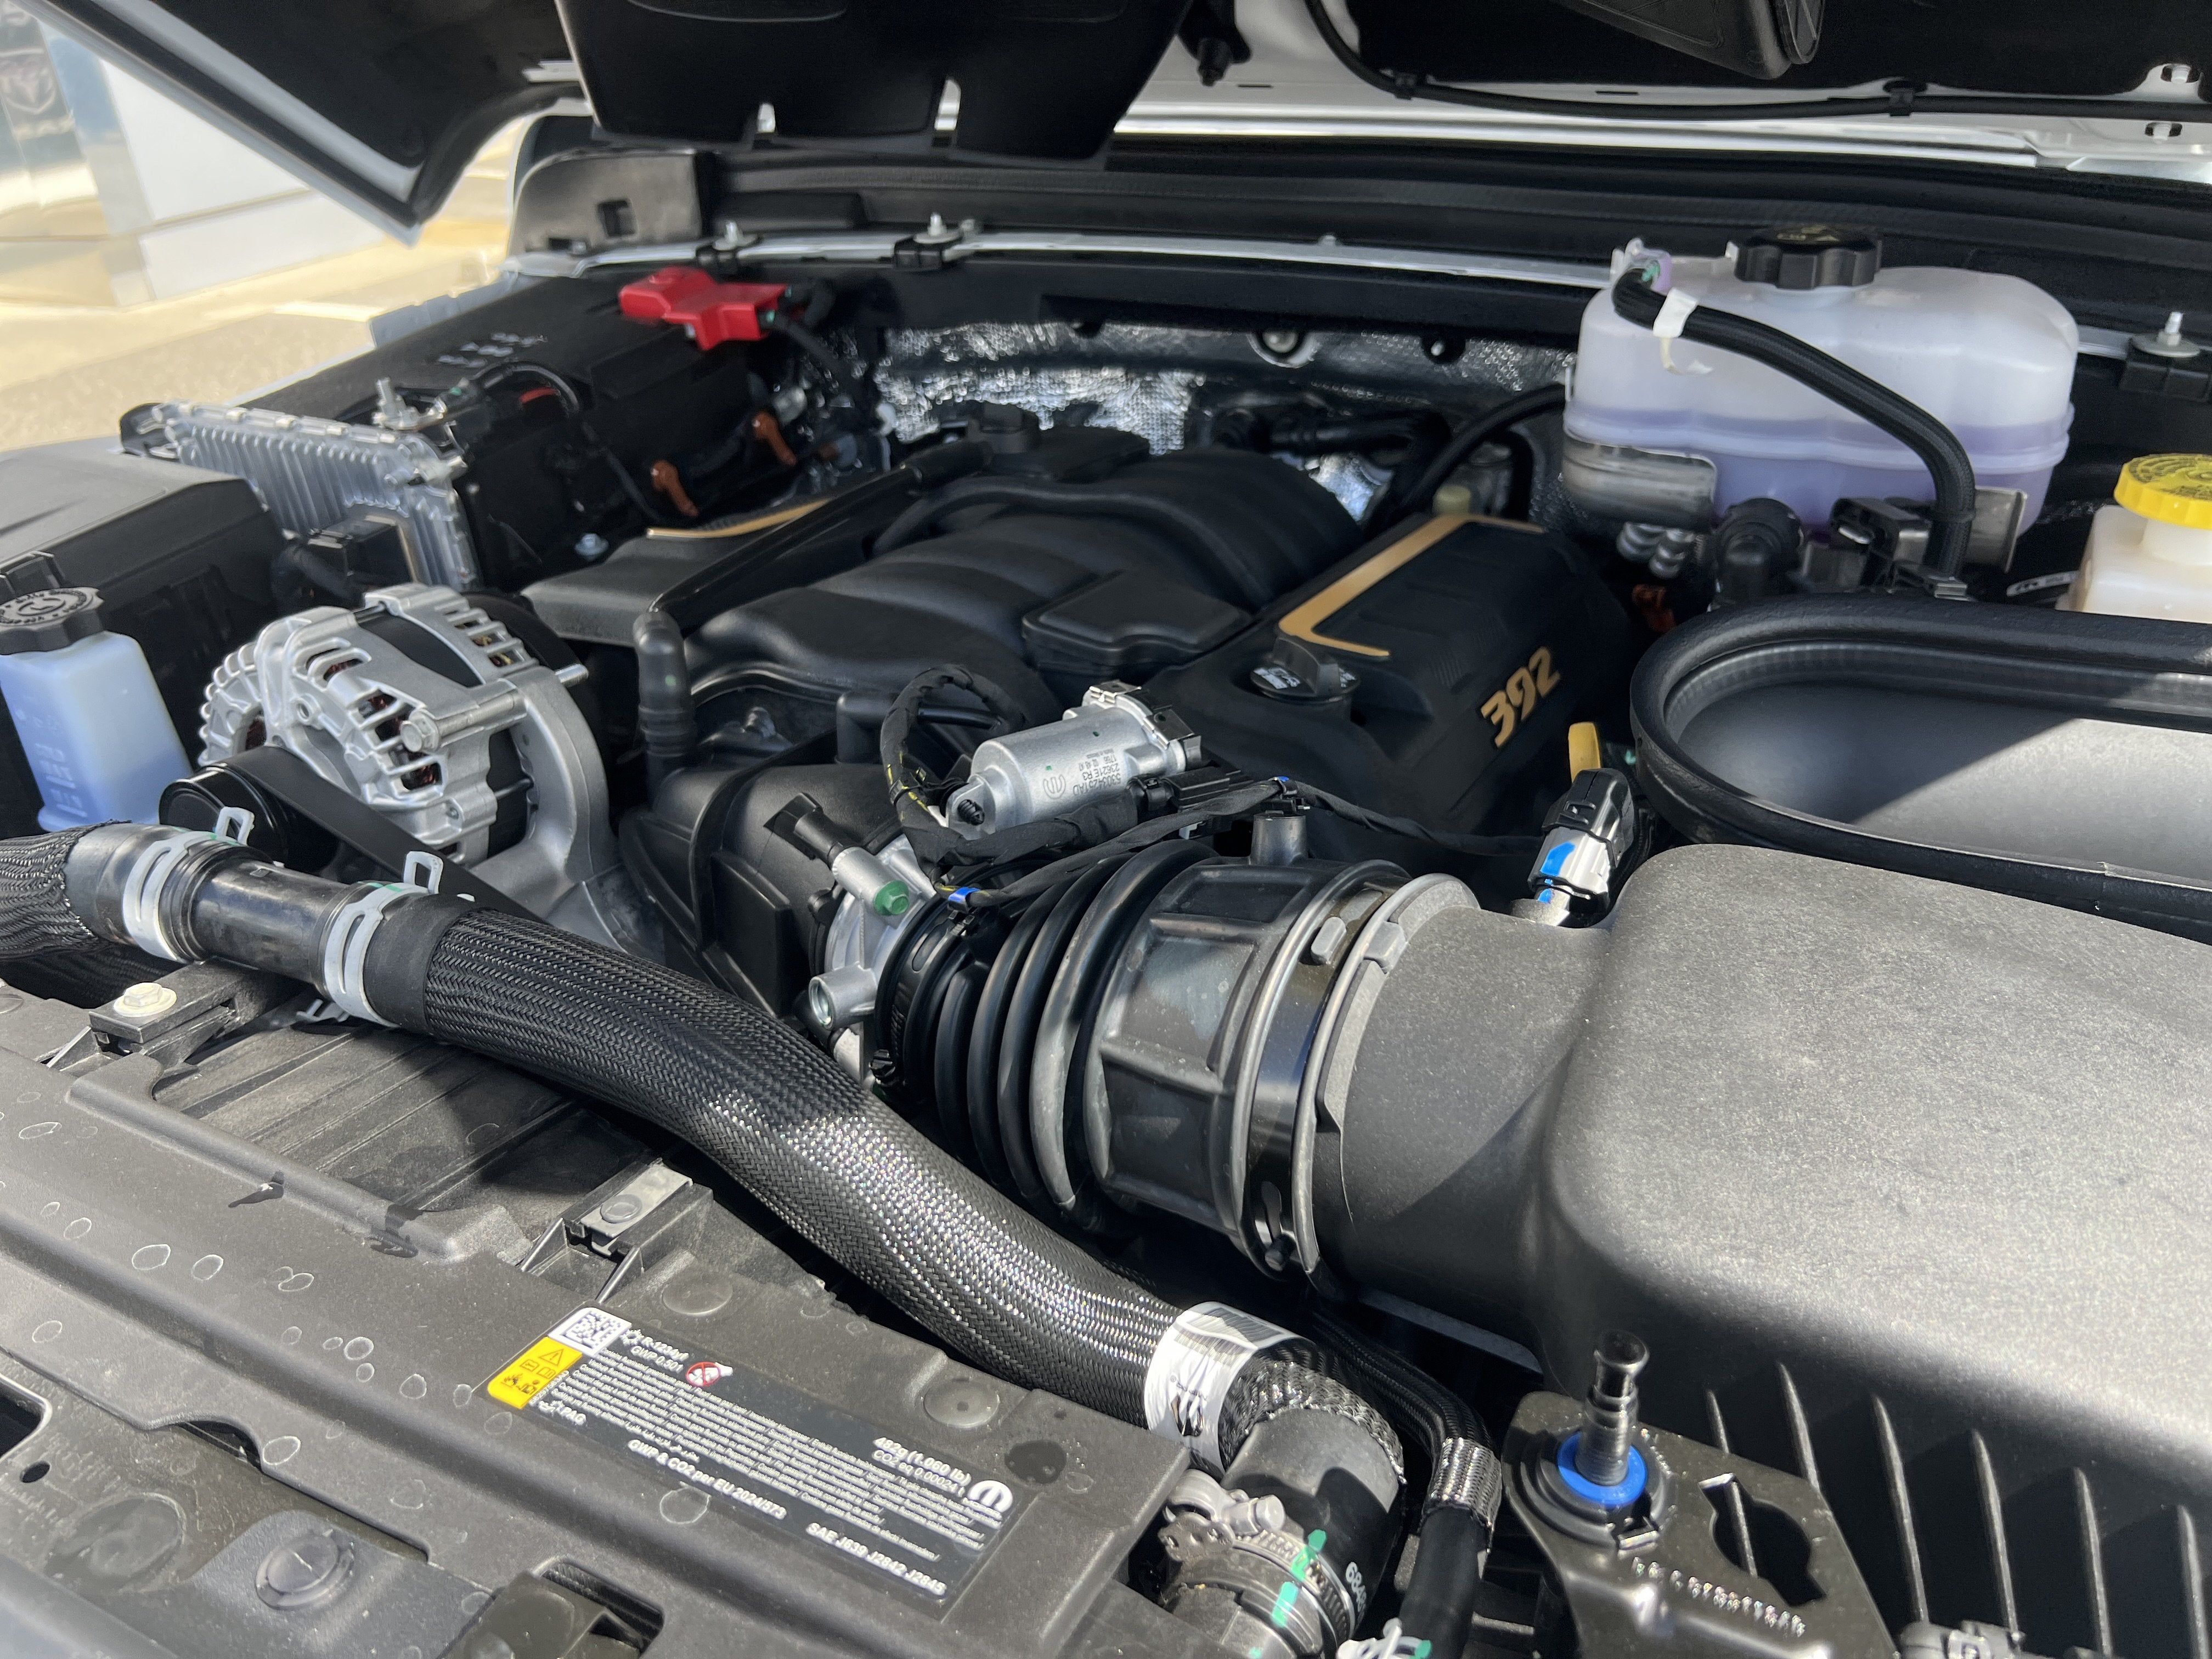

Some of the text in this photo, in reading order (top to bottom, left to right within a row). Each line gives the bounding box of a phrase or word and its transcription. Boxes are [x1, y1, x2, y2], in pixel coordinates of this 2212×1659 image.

[1481, 647, 1561, 748] 392
[631, 1346, 682, 1371] GWP 0.501
[559, 1407, 586, 1424] PAG
[628, 1440, 658, 1457] GWP
[656, 1453, 668, 1464] &
[668, 1458, 695, 1476] CO2
[690, 1471, 714, 1485] per
[714, 1479, 734, 1493] EU
[732, 1488, 786, 1519] 2024/573
[873, 1450, 901, 1467] CO2
[899, 1463, 913, 1475] eq
[915, 1468, 957, 1492] 0.00024
[874, 1437, 970, 1486] 482g (1.060 lb)
[806, 1523, 946, 1594] SAE J639 J2842 J2845
